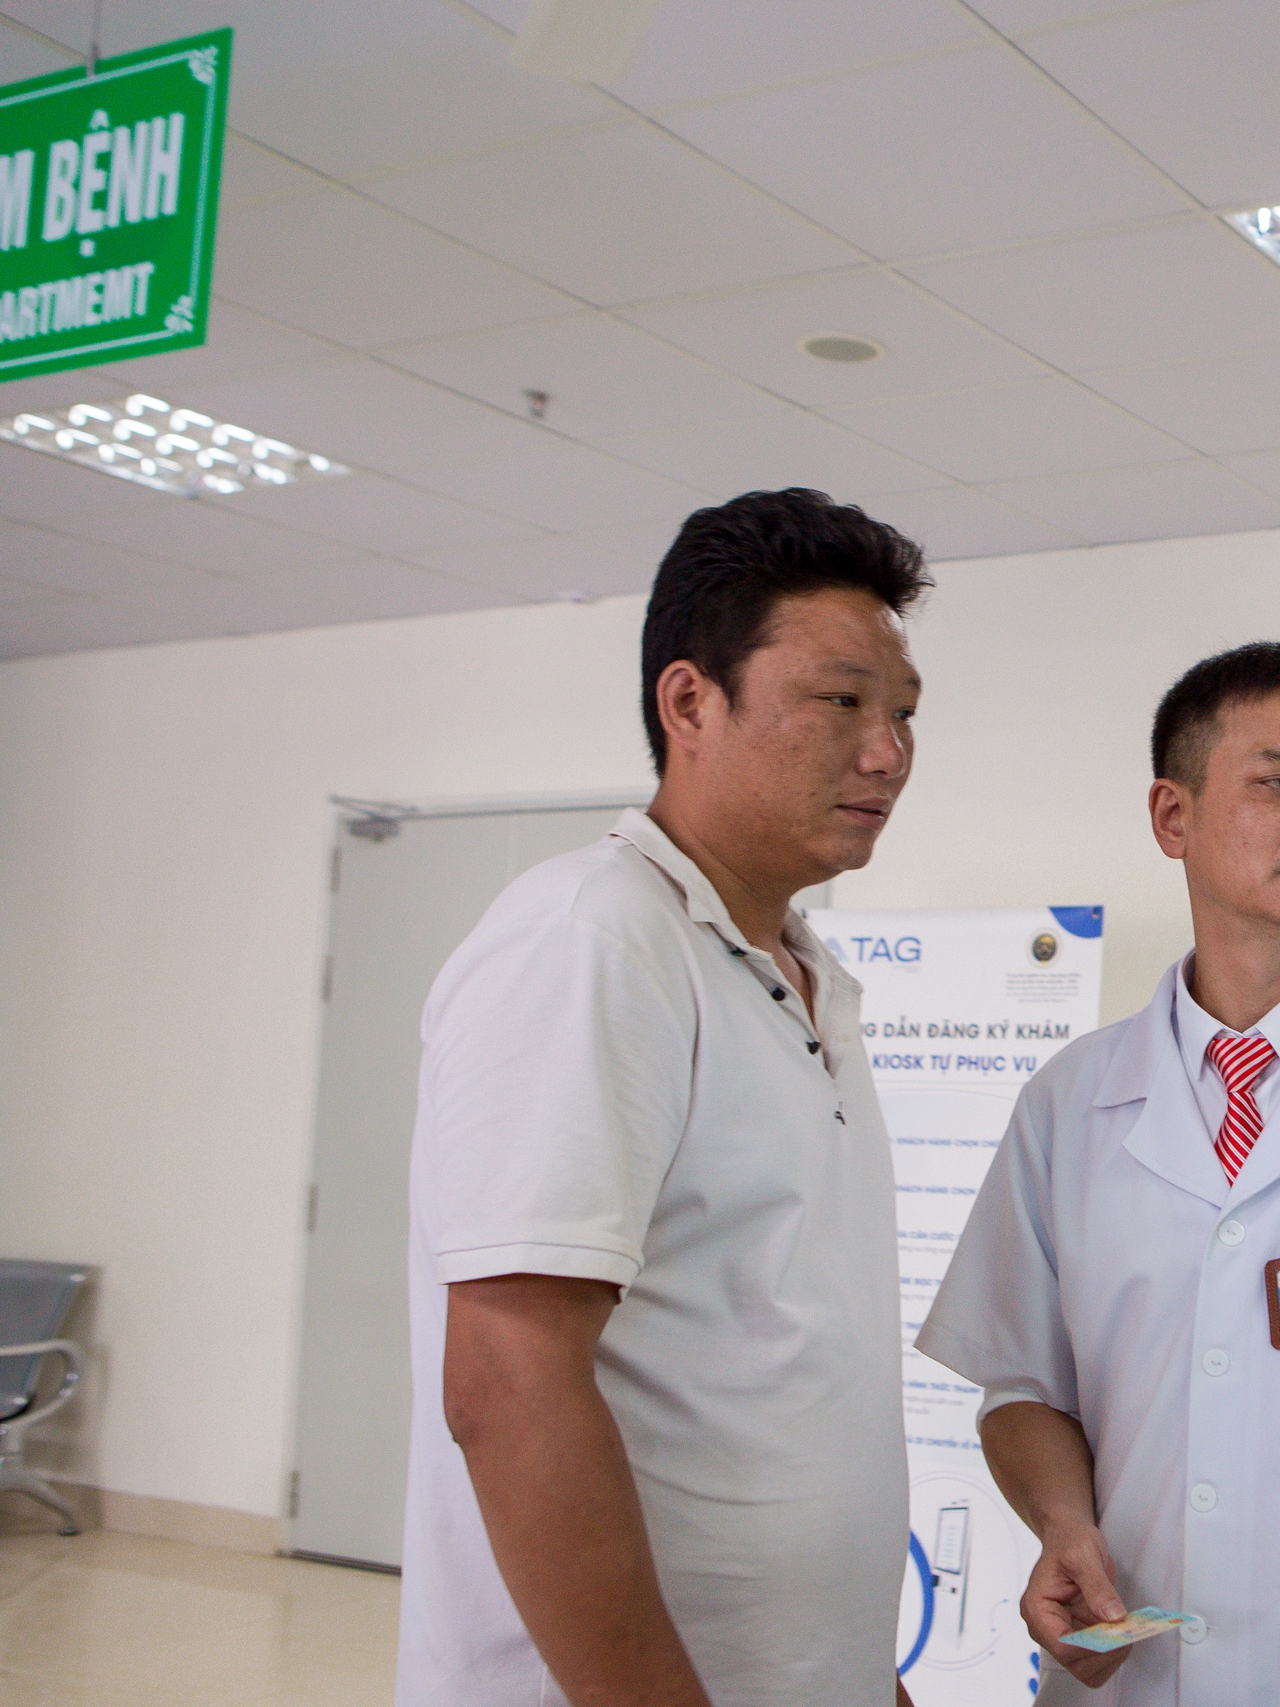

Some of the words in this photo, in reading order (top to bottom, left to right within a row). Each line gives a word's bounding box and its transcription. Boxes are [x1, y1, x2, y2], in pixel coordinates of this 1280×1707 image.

[42, 109, 185, 257] BỆNH
[851, 936, 922, 963] TAG
[883, 1015, 920, 1038] DẪN
[927, 1018, 980, 1039] ĐĂNG
[987, 1018, 1010, 1039] KÝ
[1015, 1018, 1070, 1040] KHÁM
[872, 1054, 924, 1071] KIOSK
[930, 1053, 953, 1075] TỰ
[956, 1054, 1006, 1076] PHỤC
[1012, 1056, 1038, 1077] VỤ
